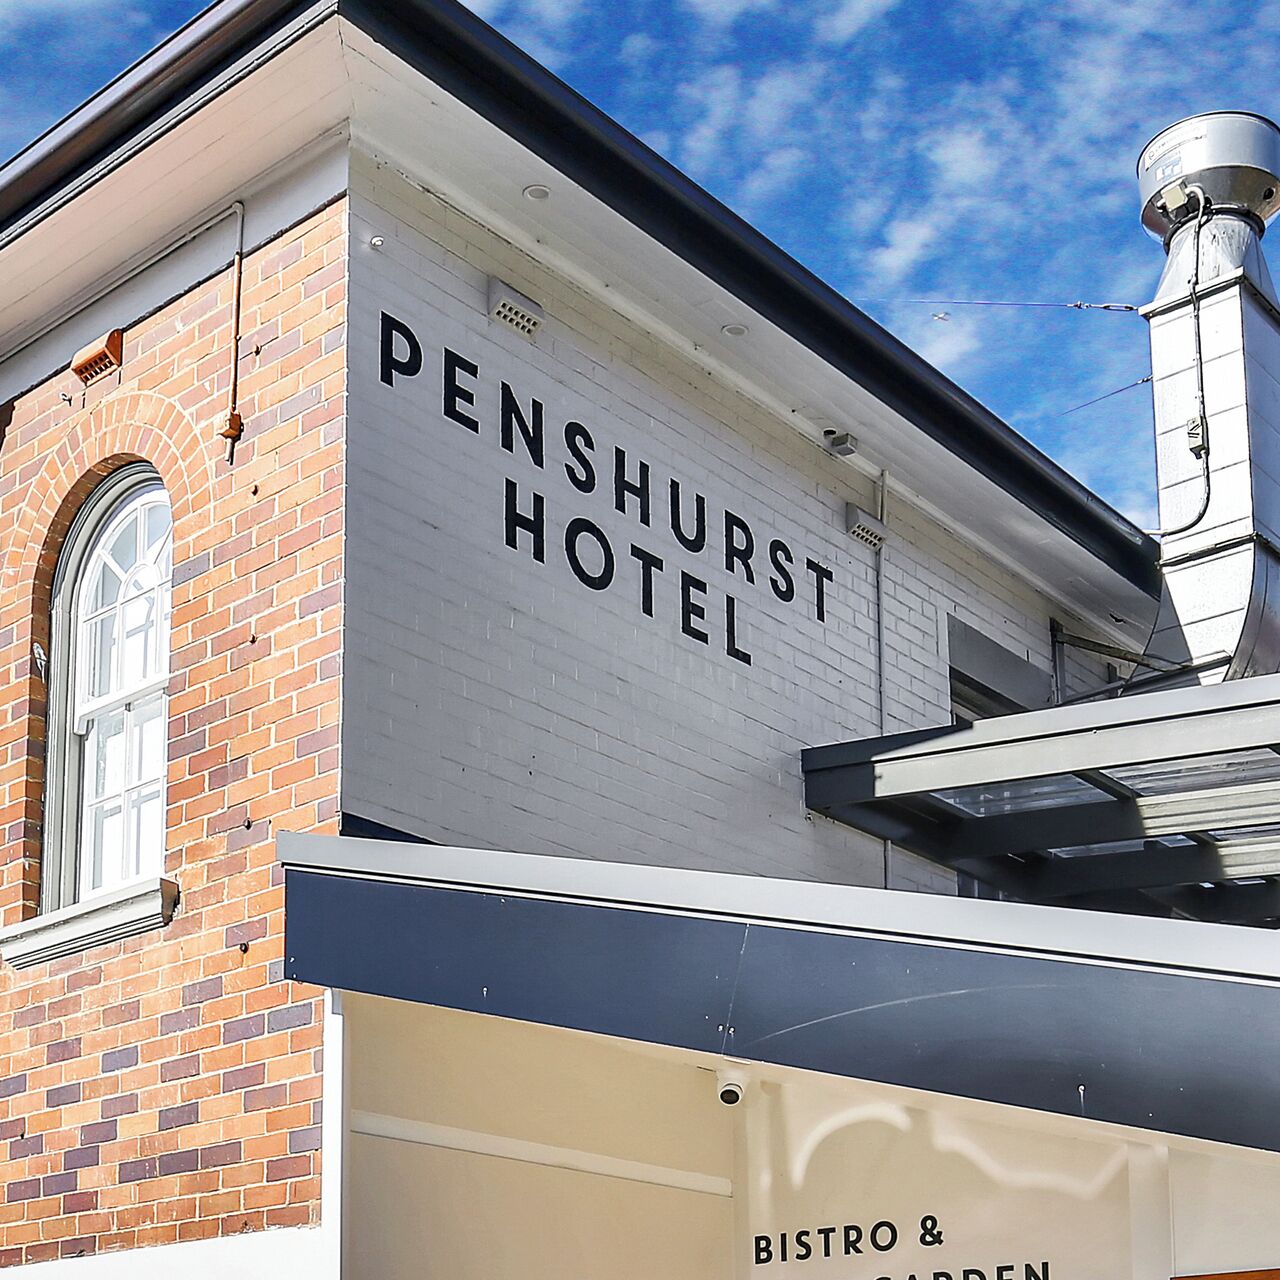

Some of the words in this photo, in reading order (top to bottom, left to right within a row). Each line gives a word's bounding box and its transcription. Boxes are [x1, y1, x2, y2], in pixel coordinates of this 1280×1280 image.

[380, 310, 833, 623] PENSHURST
[505, 477, 752, 666] HOTEL
[753, 1220, 898, 1264] BISTRO
[919, 1214, 944, 1246] &
